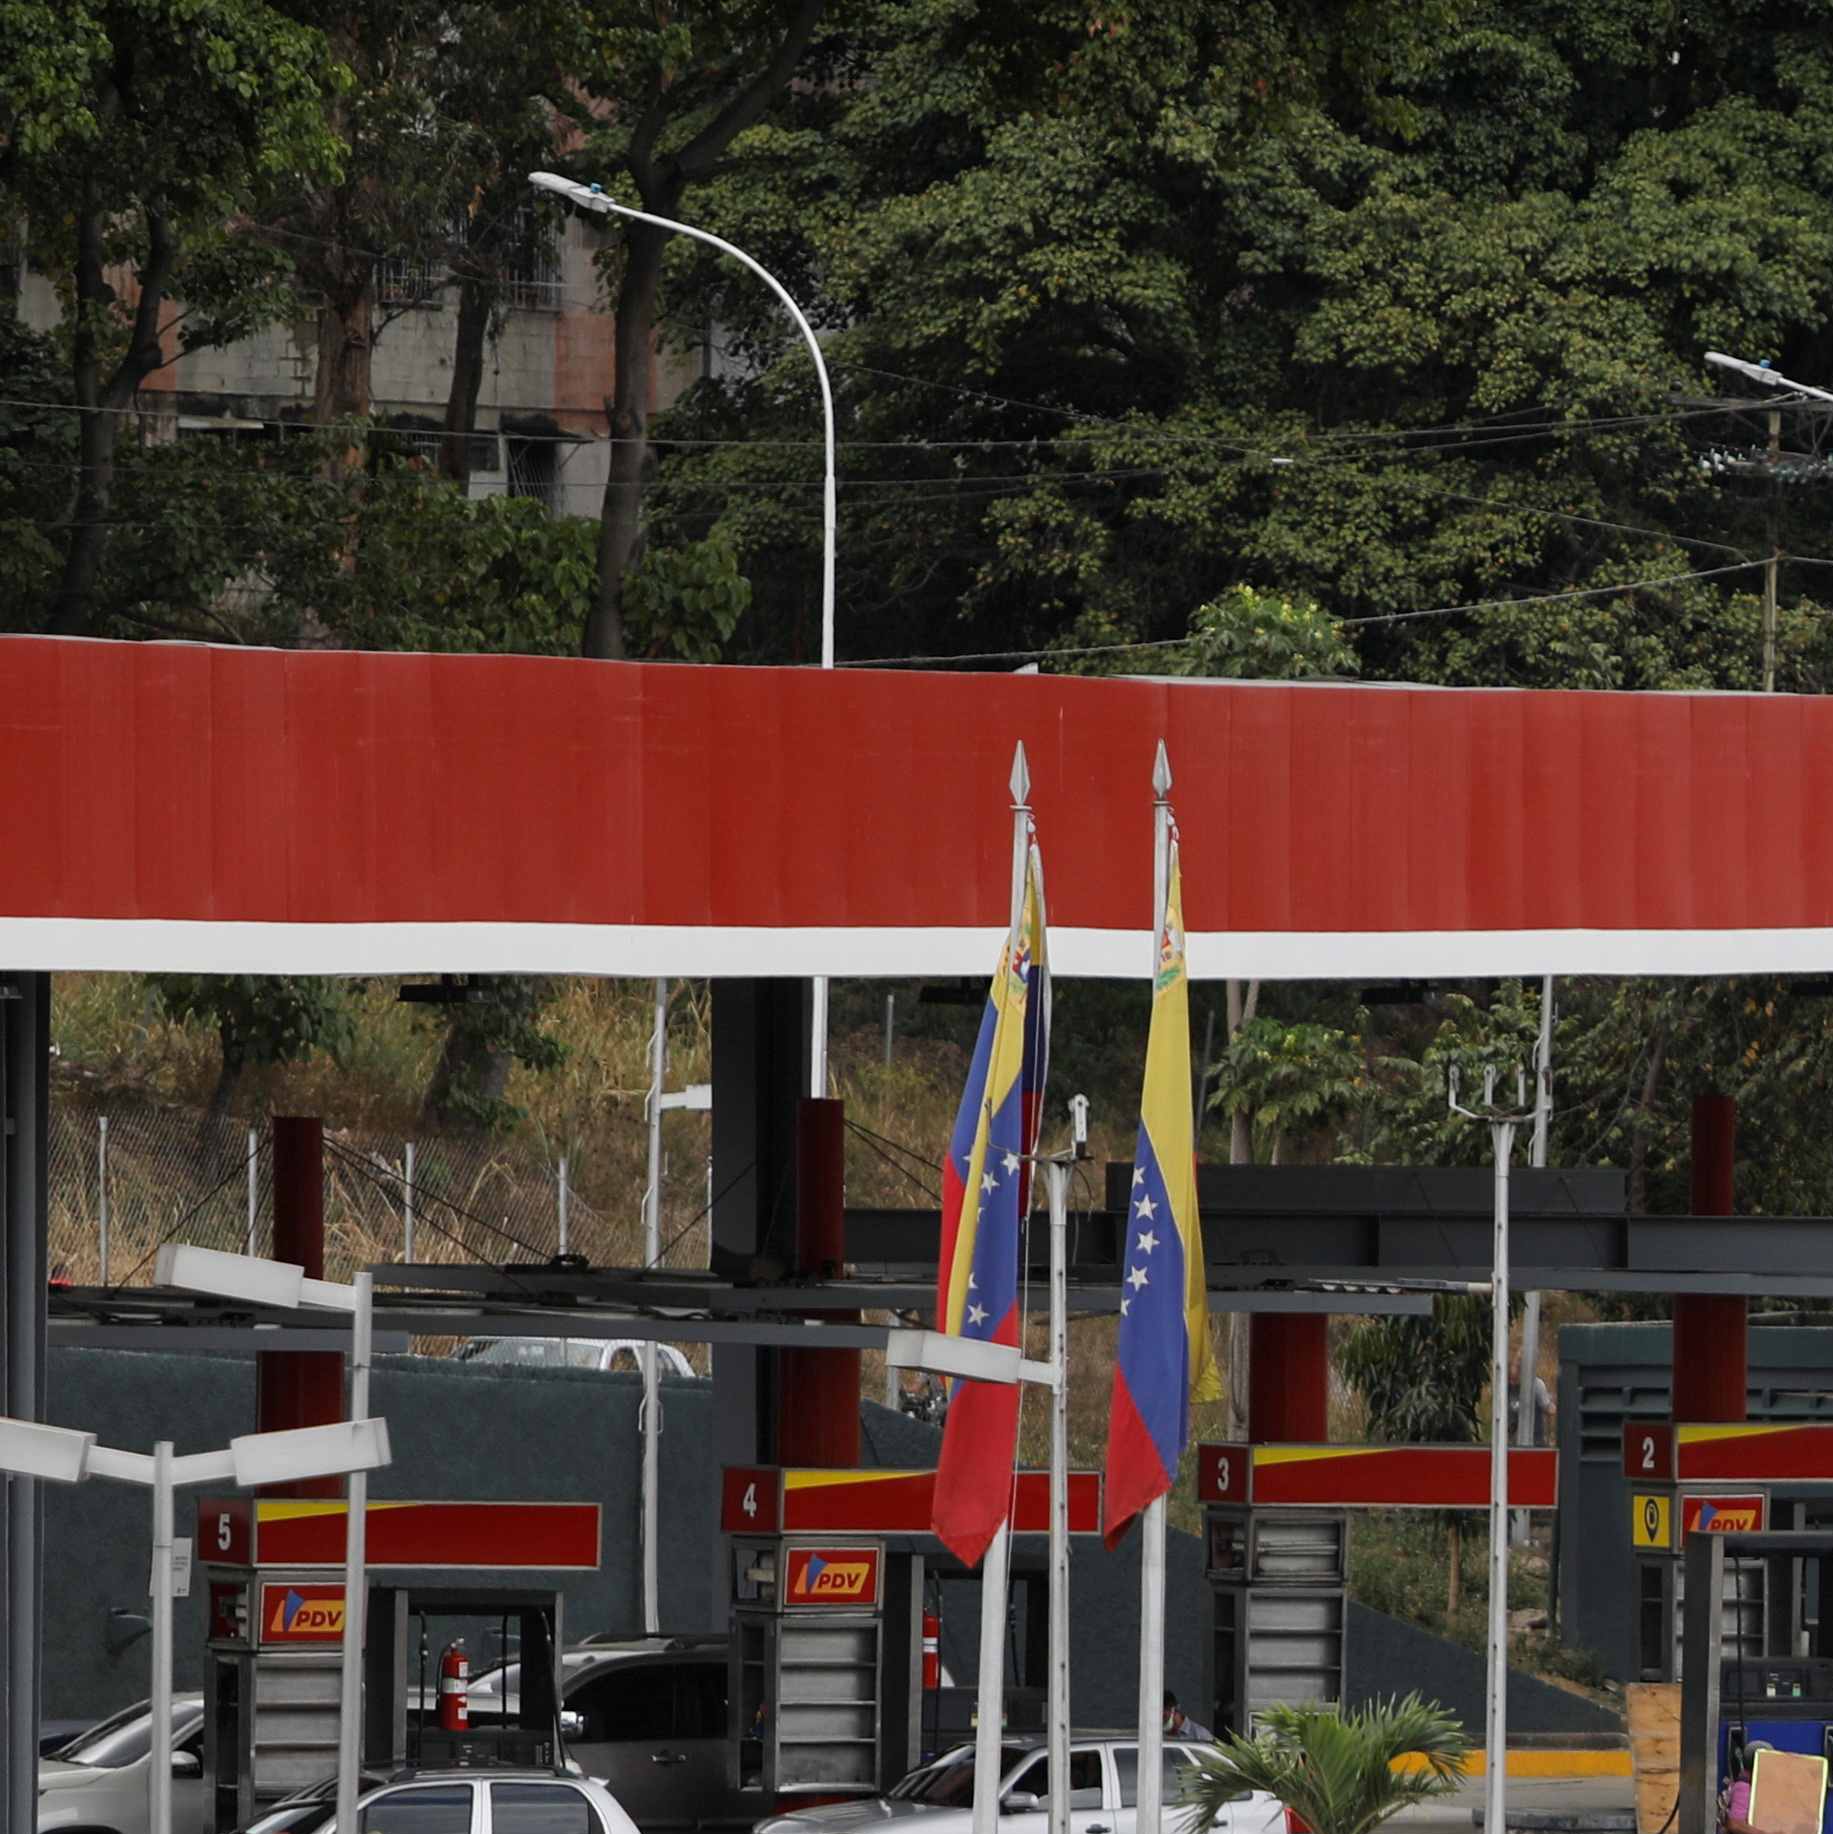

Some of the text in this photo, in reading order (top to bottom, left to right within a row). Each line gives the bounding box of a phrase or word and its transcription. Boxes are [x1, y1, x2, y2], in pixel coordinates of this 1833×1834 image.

[1642, 1436, 1655, 1469] 2
[1217, 1457, 1230, 1492] 3
[743, 1483, 757, 1518] 4
[217, 1513, 231, 1551] 5
[817, 1572, 861, 1589] PDV
[296, 1610, 342, 1628] PDV
